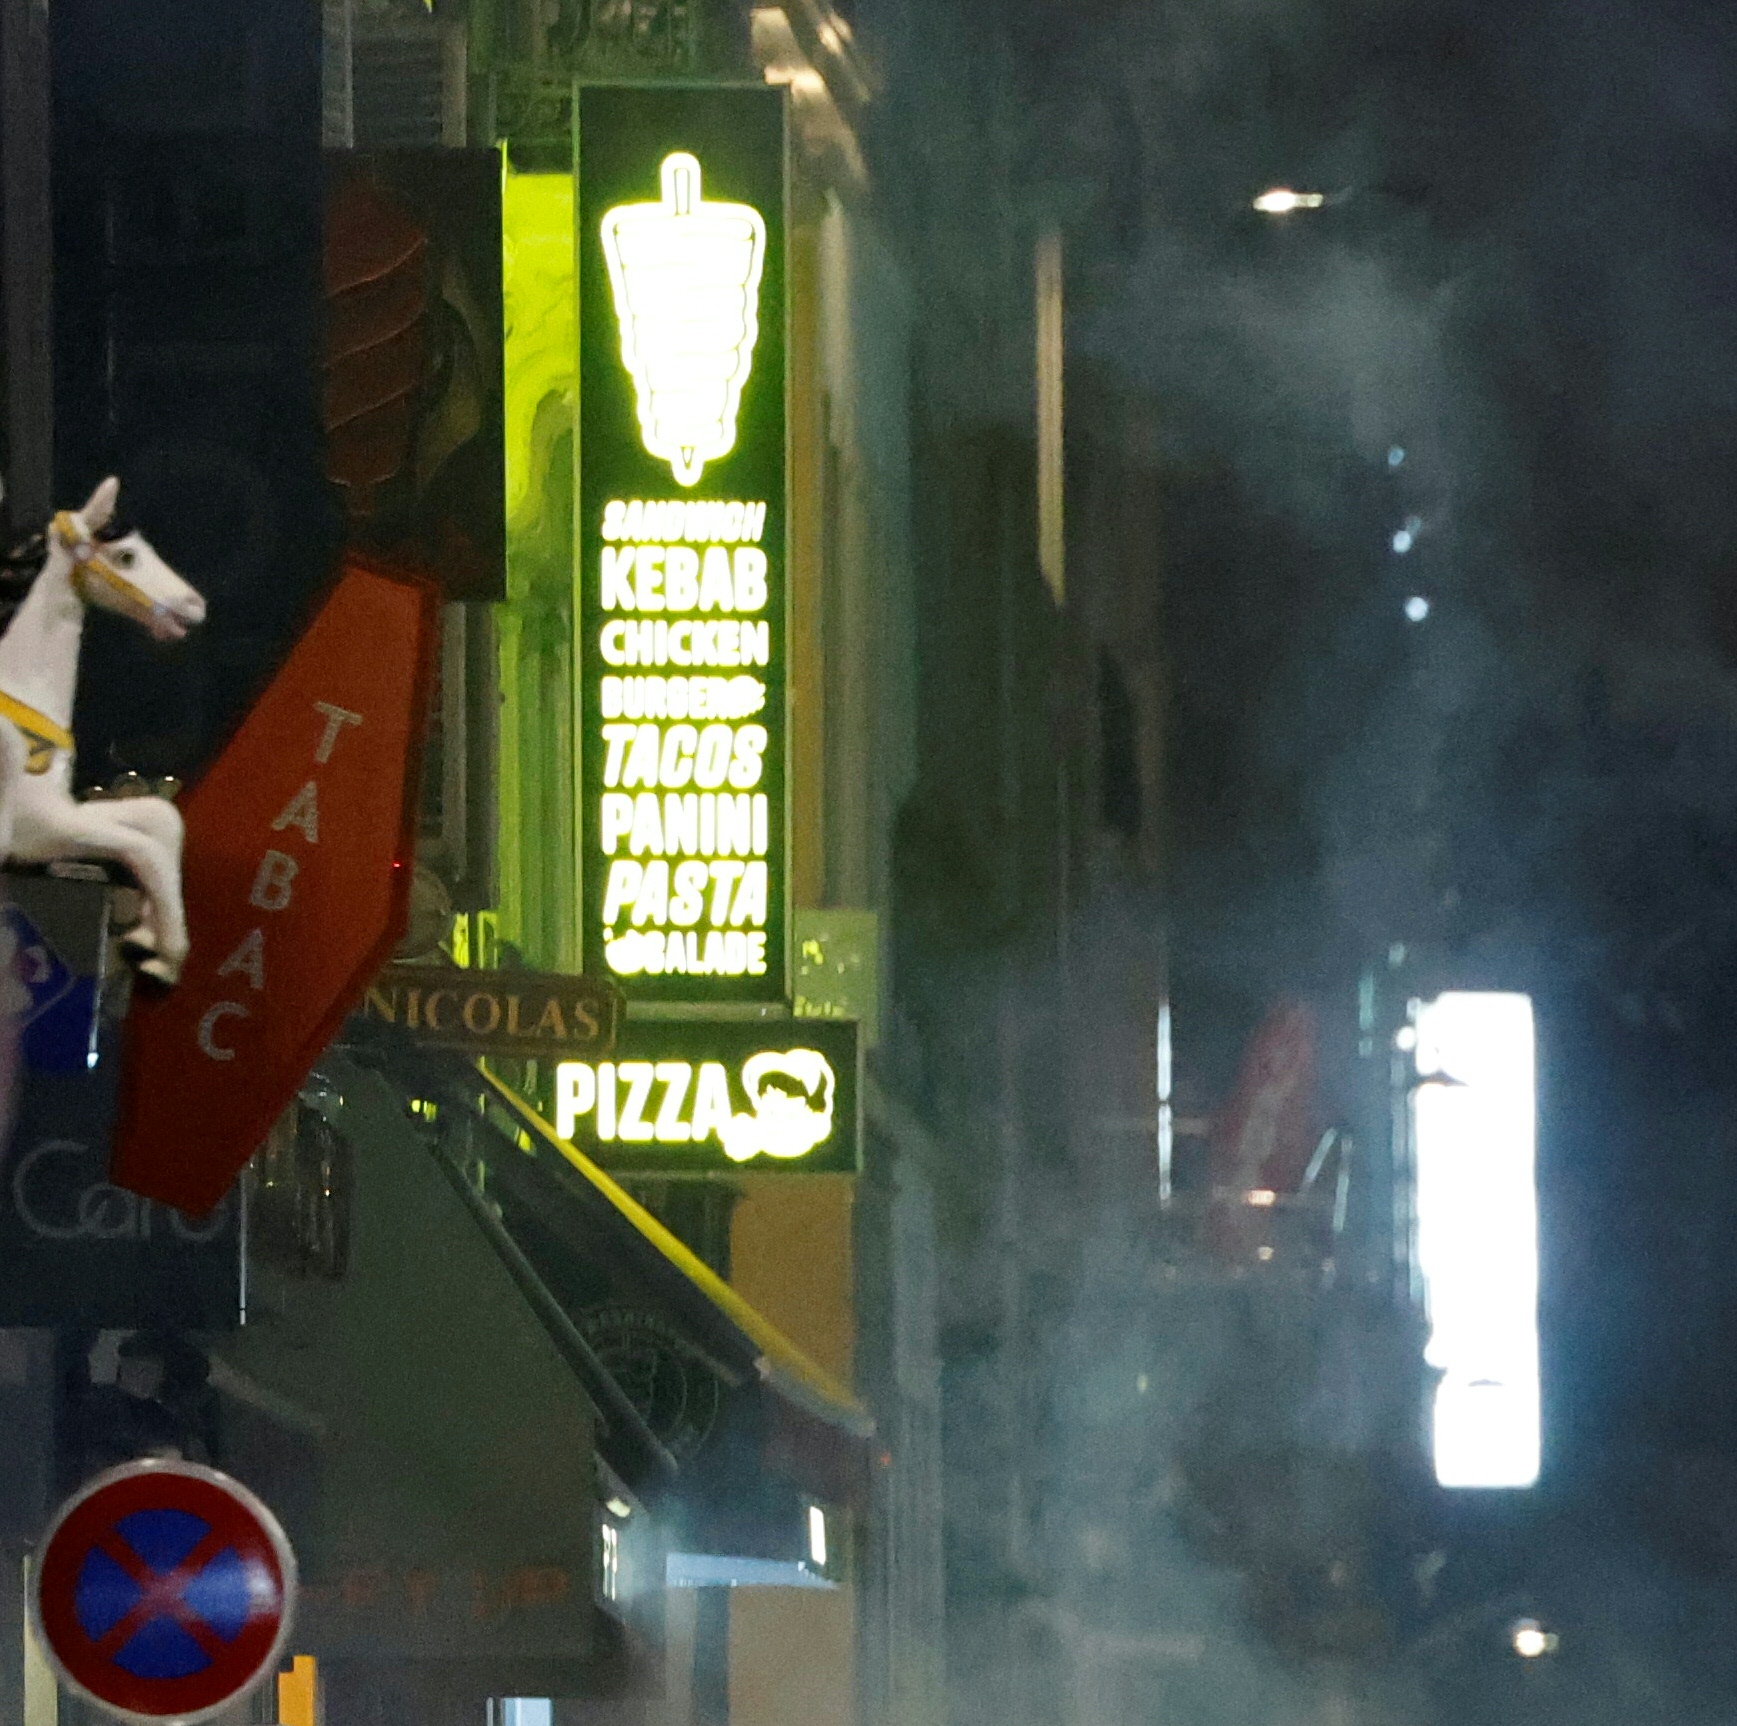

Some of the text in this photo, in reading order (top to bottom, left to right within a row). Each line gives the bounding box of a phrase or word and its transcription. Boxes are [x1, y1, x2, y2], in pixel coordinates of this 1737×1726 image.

[602, 500, 766, 542] SANDWICH
[601, 545, 768, 612] KEBAB
[600, 619, 770, 667] CHICKEN
[601, 723, 768, 788] TACOS
[601, 792, 768, 856] PANINI
[198, 700, 363, 1061] TABAC
[602, 859, 768, 926] PASTA
[364, 985, 600, 1044] NICOLAS
[555, 1061, 733, 1141] PIZZA
